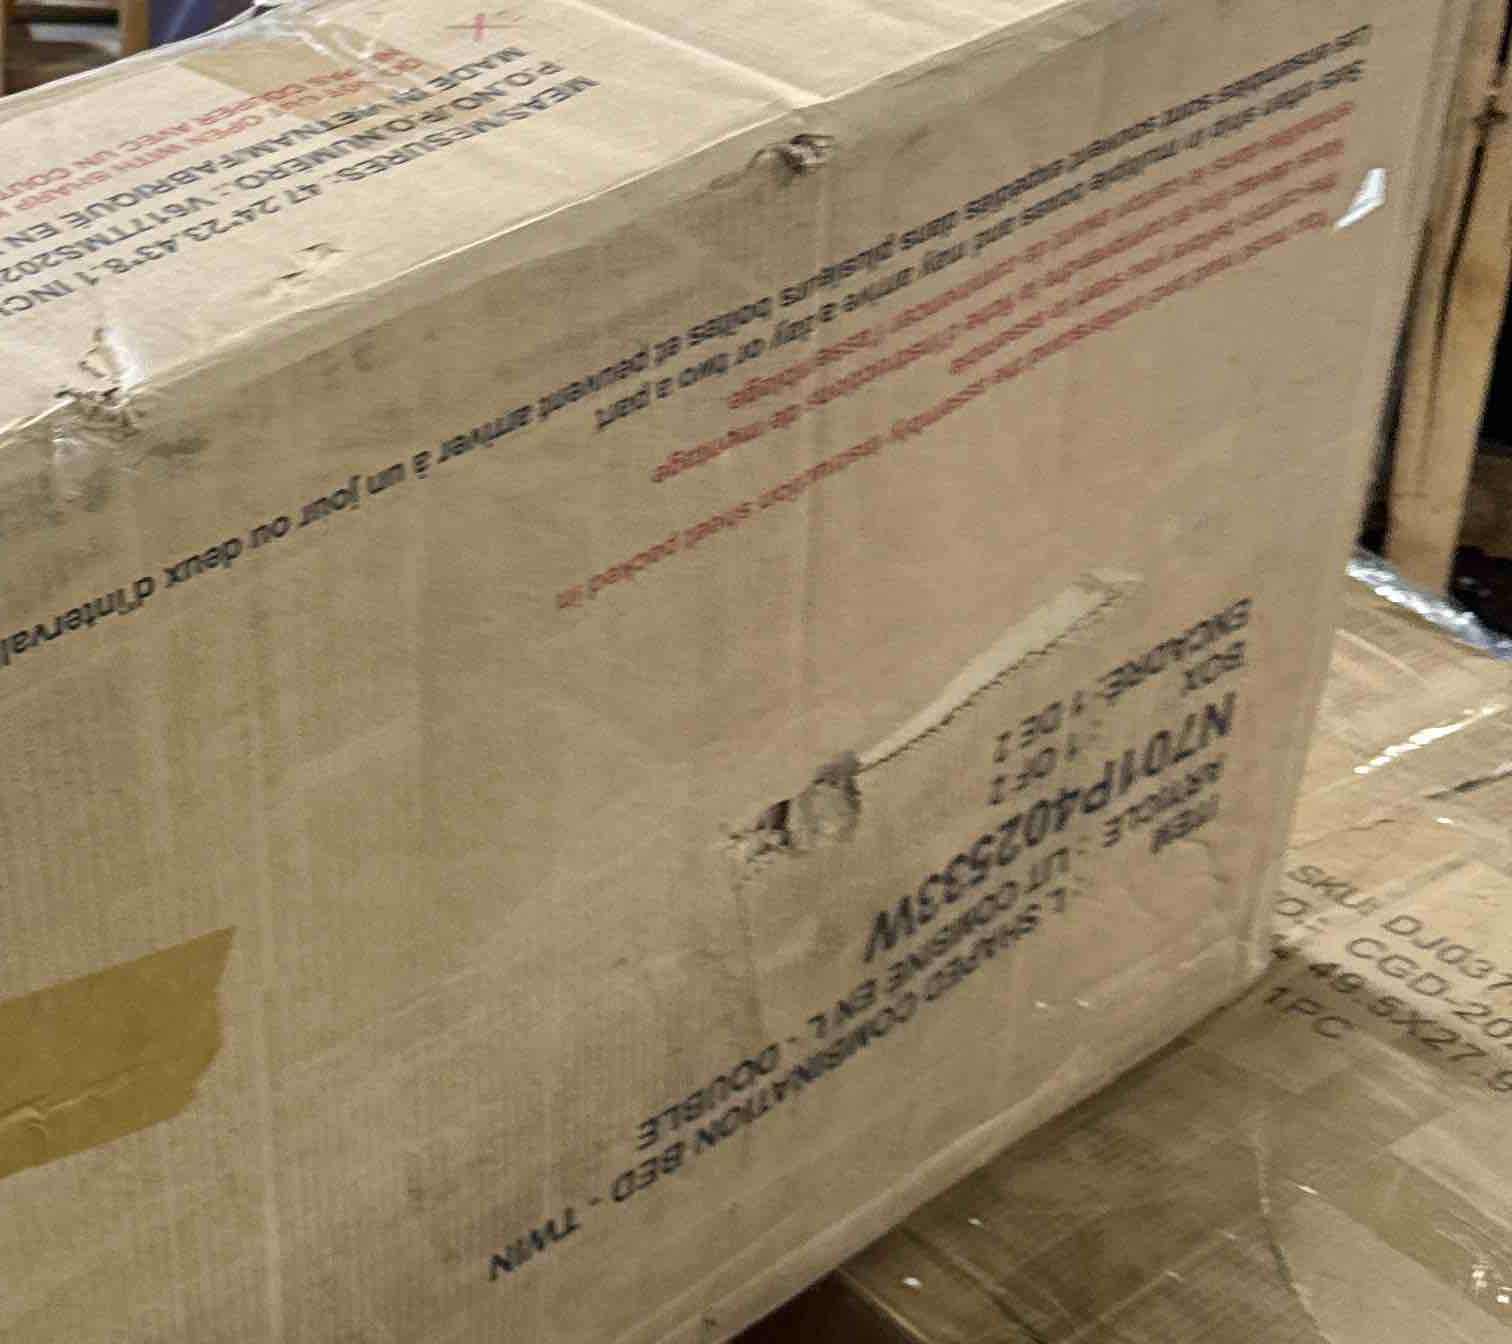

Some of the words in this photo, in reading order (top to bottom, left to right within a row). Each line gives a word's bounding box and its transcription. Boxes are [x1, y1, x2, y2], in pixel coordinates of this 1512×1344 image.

[417, 46, 528, 90] MADE
[0, 223, 69, 249] EN
[536, 339, 650, 416] peuvent
[677, 348, 730, 395] two
[734, 332, 765, 368] or
[437, 401, 533, 469] arriver
[592, 384, 650, 434] part
[297, 470, 362, 535] jour
[364, 459, 406, 500] un
[249, 511, 290, 550] ou
[163, 533, 243, 597] deux
[859, 685, 1237, 969] N701P402533W
[834, 973, 879, 1031] EN
[1346, 937, 1512, 1049] CGD-20
[802, 1004, 830, 1051] L
[631, 1035, 781, 1161] DOUBLE
[690, 984, 920, 1161] COMBINATION
[604, 1136, 684, 1214] BED
[484, 1199, 583, 1289] TWIN
